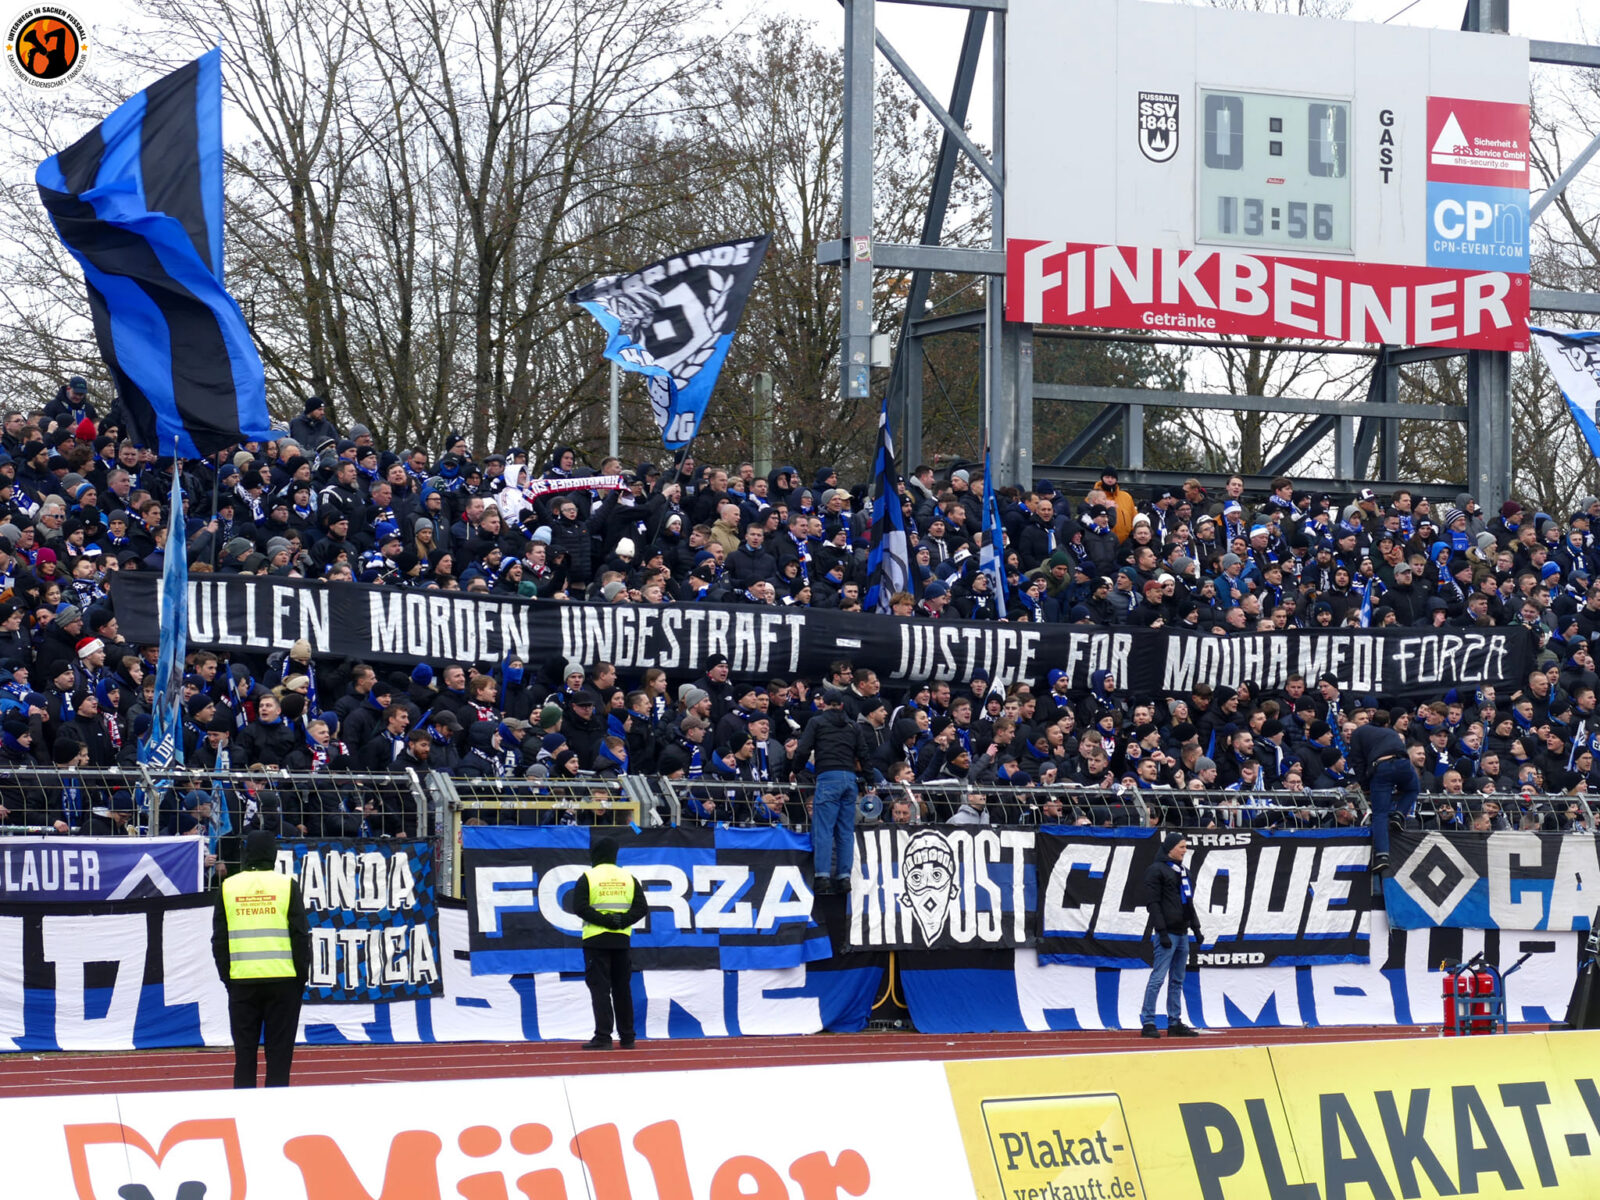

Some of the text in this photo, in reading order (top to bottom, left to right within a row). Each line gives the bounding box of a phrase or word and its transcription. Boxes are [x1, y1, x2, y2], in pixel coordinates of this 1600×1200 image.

[1140, 93, 1177, 103] FUSSBALL
[1140, 101, 1177, 117] SSV
[1140, 115, 1177, 131] 1846
[1379, 109, 1394, 184] GAST
[1473, 137, 1511, 148] Sicherheit
[1473, 148, 1526, 160] Service GmbH
[1433, 240, 1523, 257] CPN-EVENT.COM
[1023, 241, 1512, 345] FINKBEINER
[1142, 311, 1216, 328] Getränke
[157, 578, 331, 653] ULLEN
[370, 591, 530, 664] MORDEN
[560, 605, 806, 673] UNGESTRAFT
[890, 622, 1041, 686] JUSTICE
[1067, 632, 1132, 691] FOR
[1160, 830, 1252, 847] TRAS
[0, 849, 100, 892] LAUER
[1044, 843, 1372, 946] CLQUE
[235, 906, 276, 917] STEWARD
[1197, 952, 1266, 965] NORD
[999, 1129, 1124, 1170] Plakat-
[283, 1119, 871, 1200] Müller
[1013, 1176, 1136, 1200] verkauft.de
